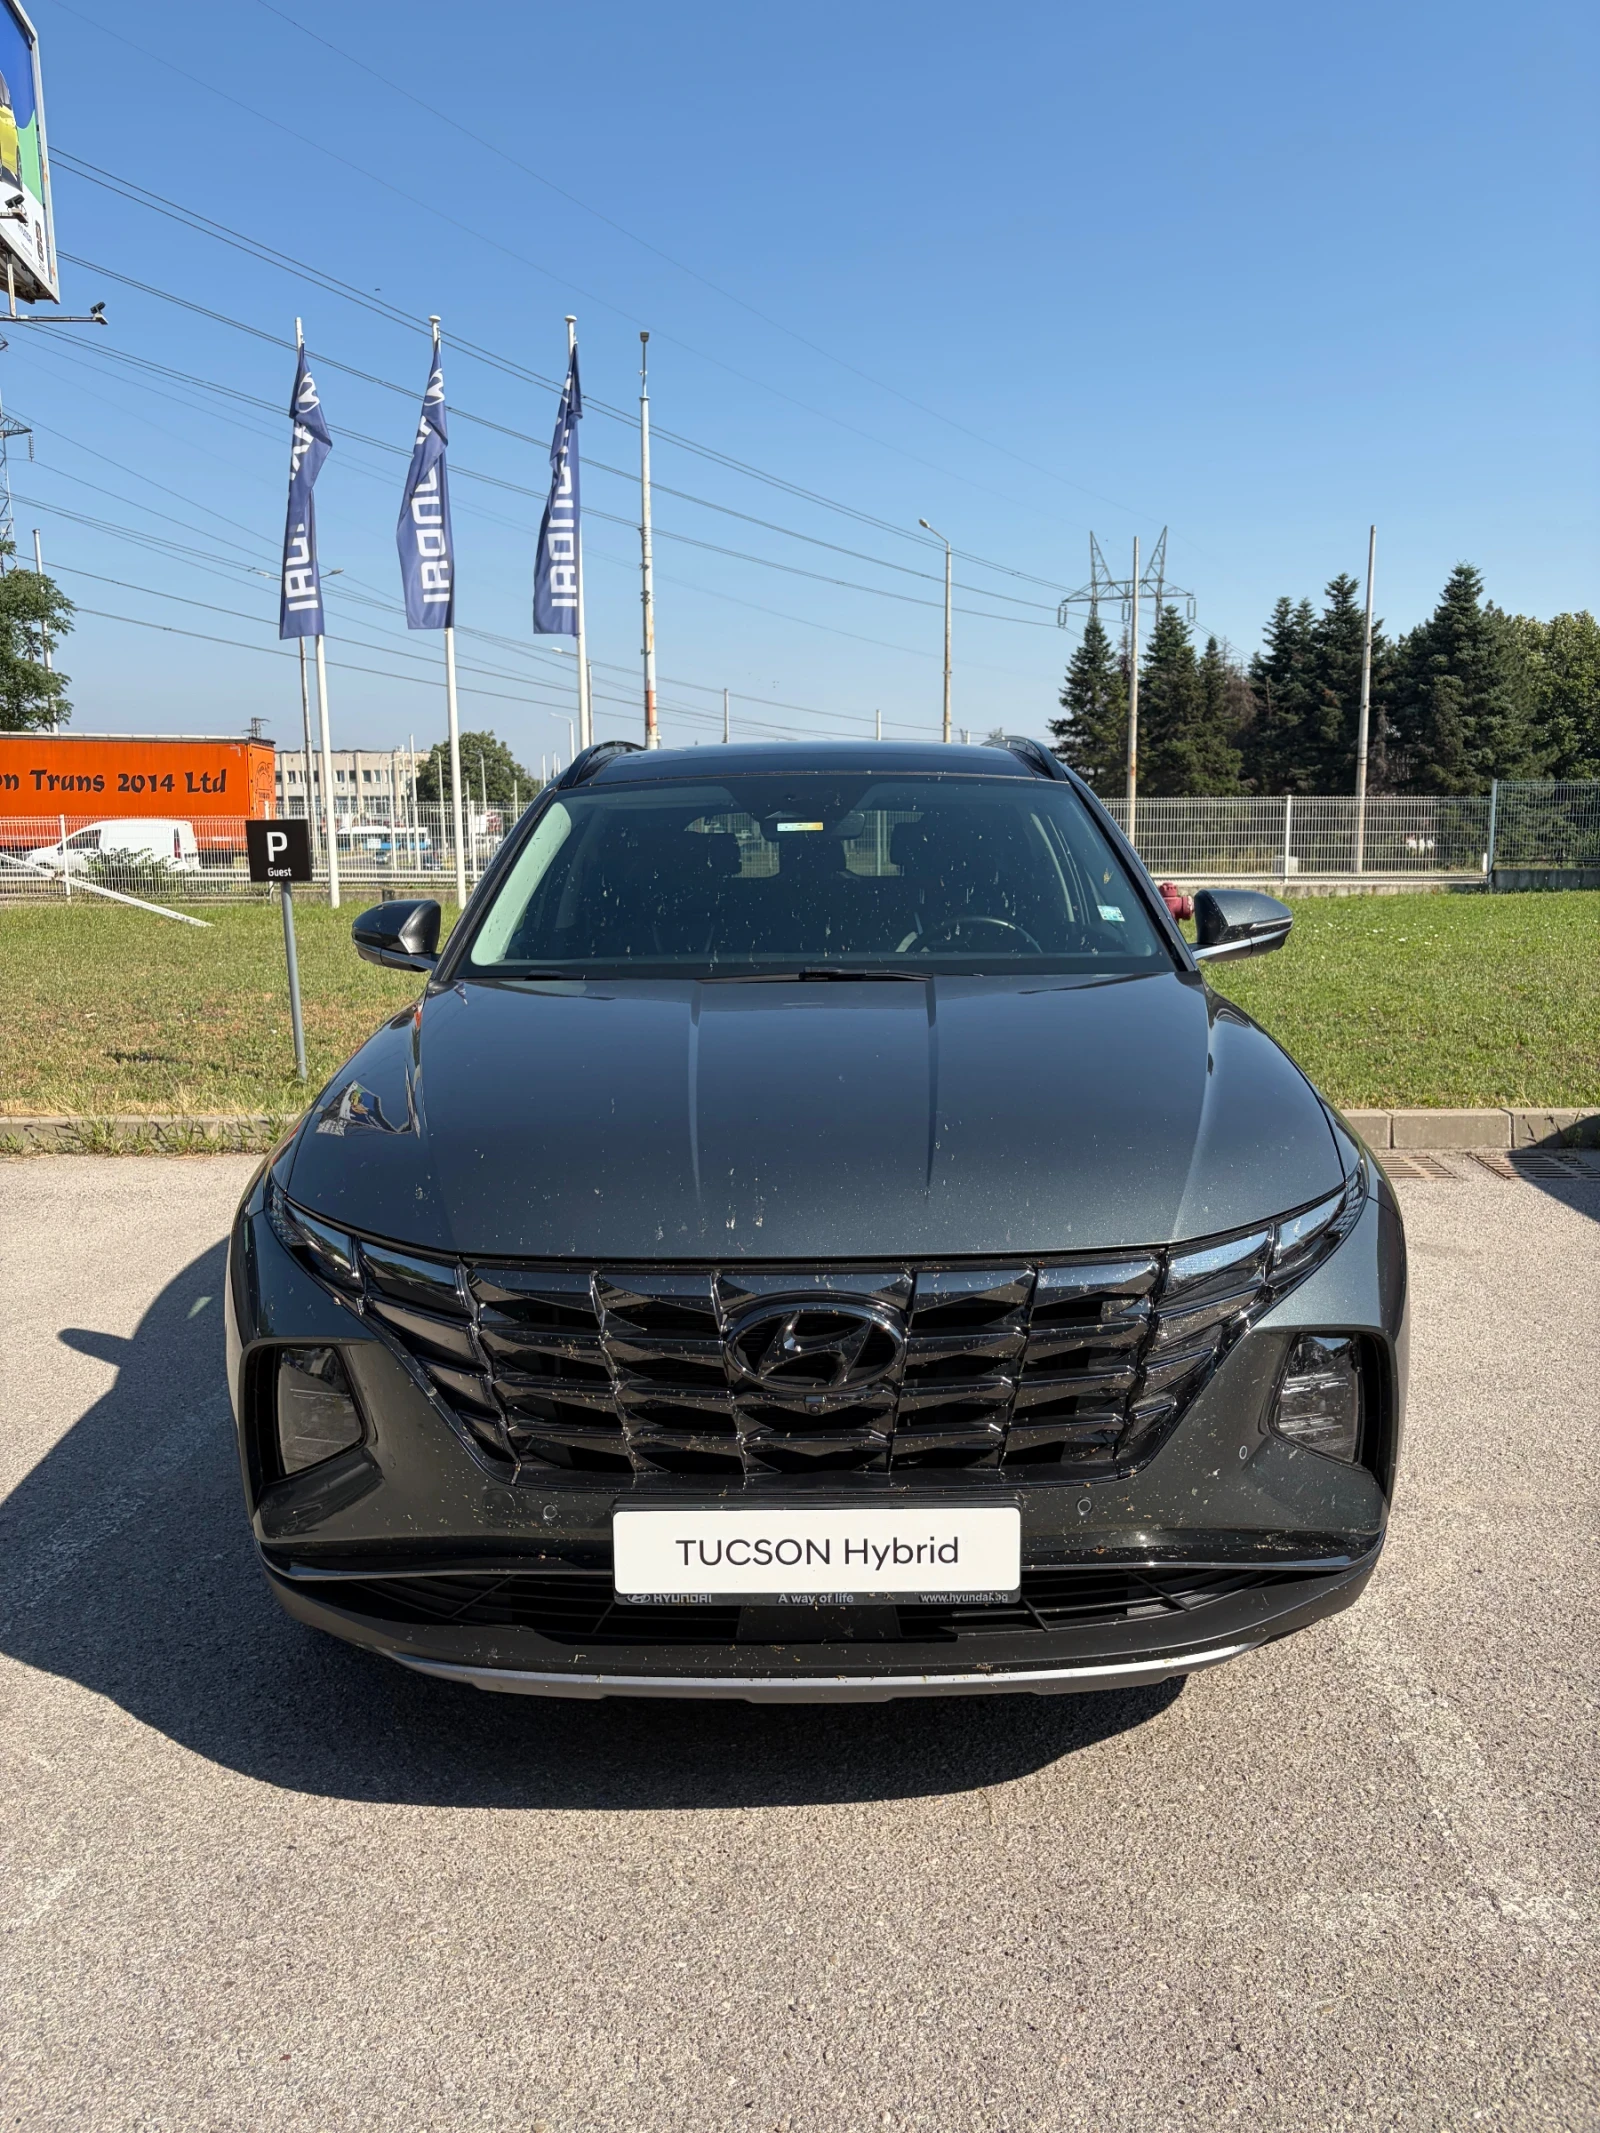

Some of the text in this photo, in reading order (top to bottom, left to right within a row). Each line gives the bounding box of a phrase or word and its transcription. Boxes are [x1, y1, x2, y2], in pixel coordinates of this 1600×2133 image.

[0, 768, 227, 793] n Trans 2014 Ltd
[266, 831, 288, 862] P
[267, 866, 292, 877] Guest
[675, 1536, 959, 1571] TUCSON Hybrid
[653, 1593, 712, 1603] HYUNDAI
[777, 1592, 854, 1606] A way of life
